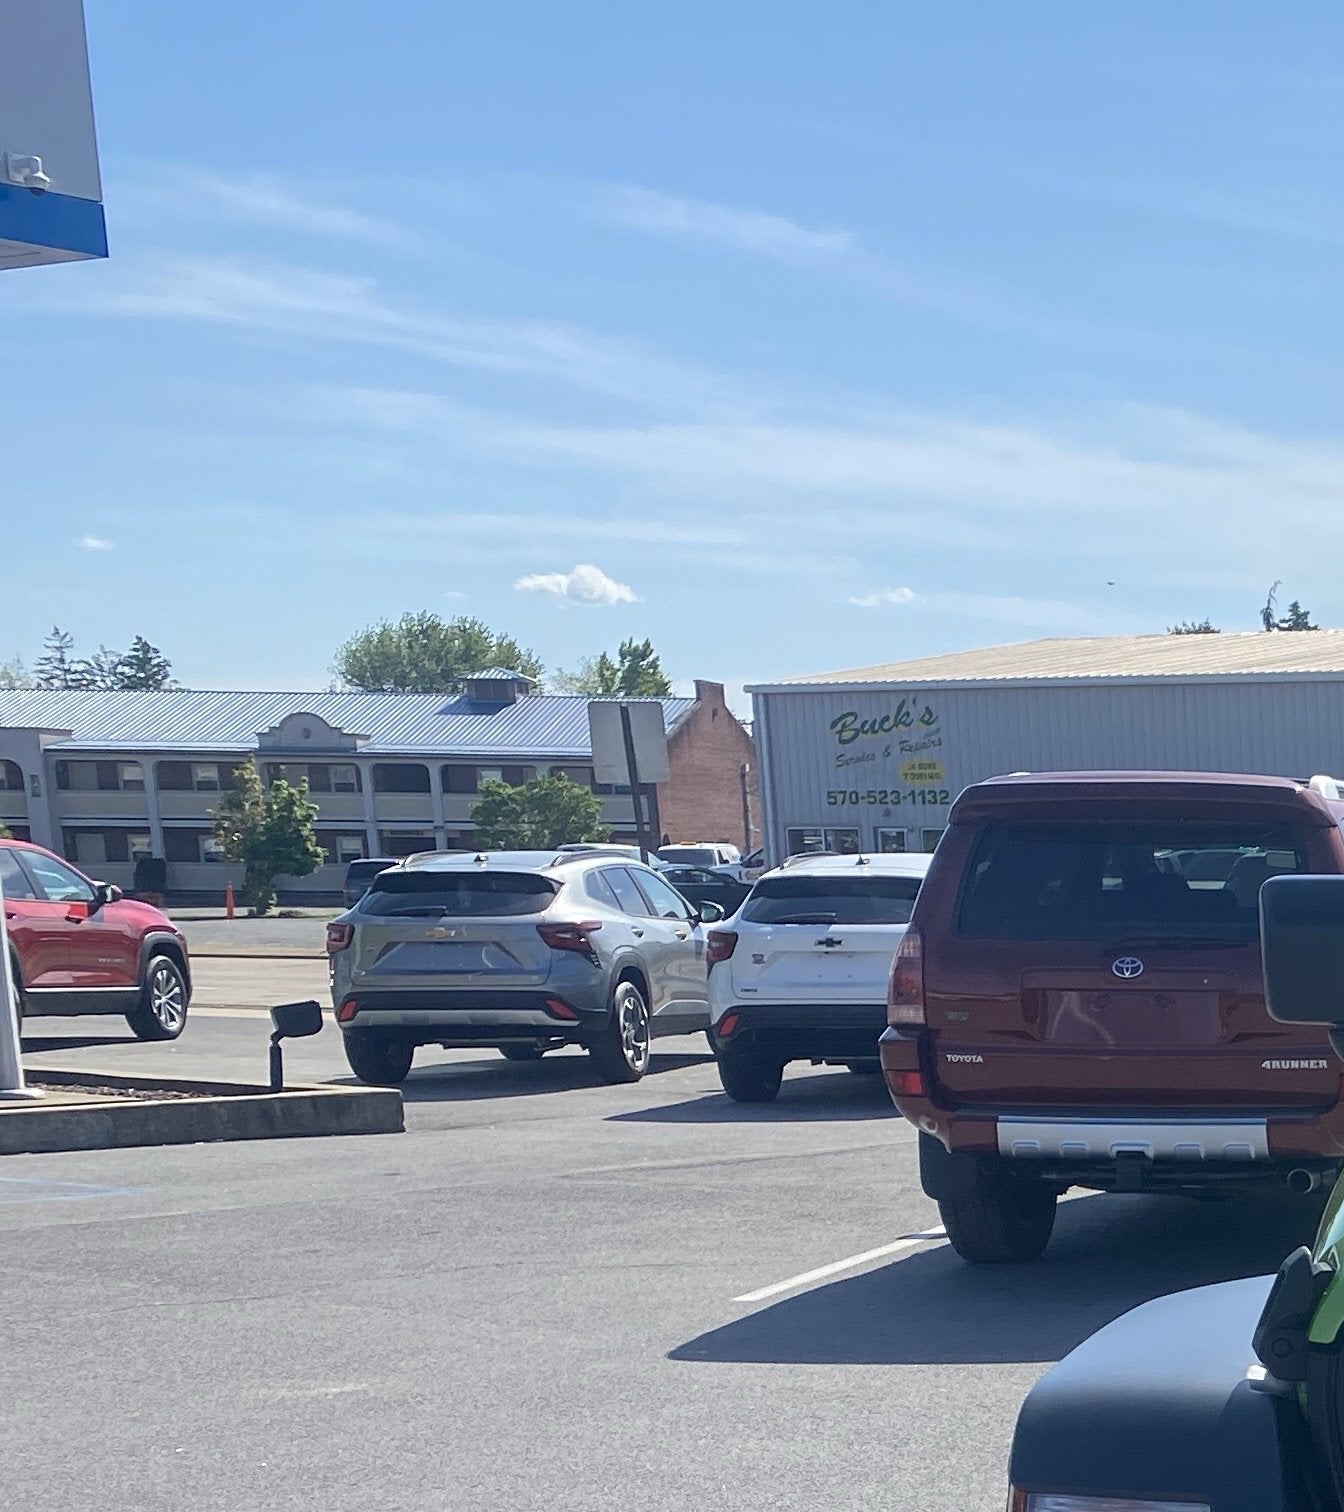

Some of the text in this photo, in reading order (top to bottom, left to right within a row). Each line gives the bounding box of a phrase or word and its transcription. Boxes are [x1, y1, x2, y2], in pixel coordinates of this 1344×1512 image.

[830, 697, 939, 745] Buck's
[826, 789, 950, 806] 570-523-1132
[946, 1054, 984, 1063] TOYOTA
[1261, 1060, 1328, 1069] 4RUNNER
